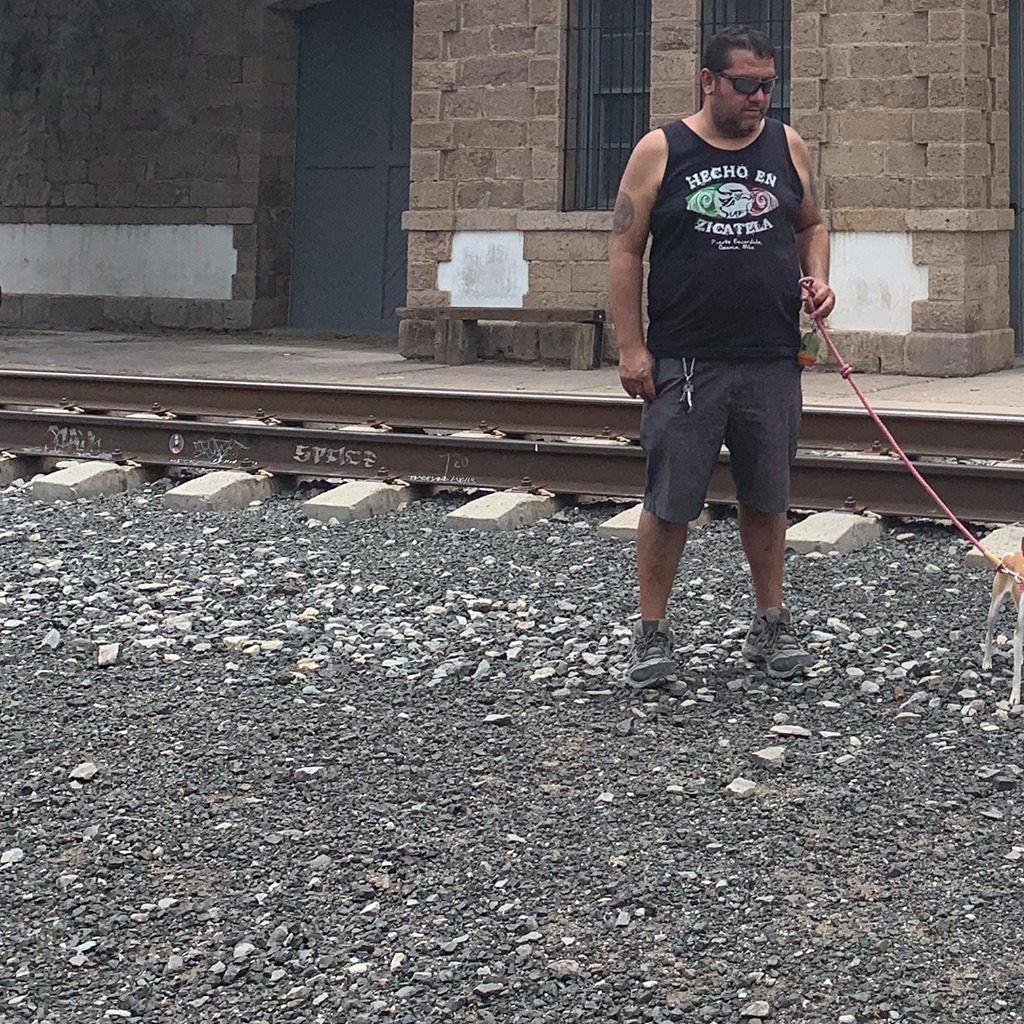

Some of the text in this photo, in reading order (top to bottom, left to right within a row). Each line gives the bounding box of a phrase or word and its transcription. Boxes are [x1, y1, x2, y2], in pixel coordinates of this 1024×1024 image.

[685, 164, 778, 189] HECHO EN
[694, 217, 774, 235] ZICATELA
